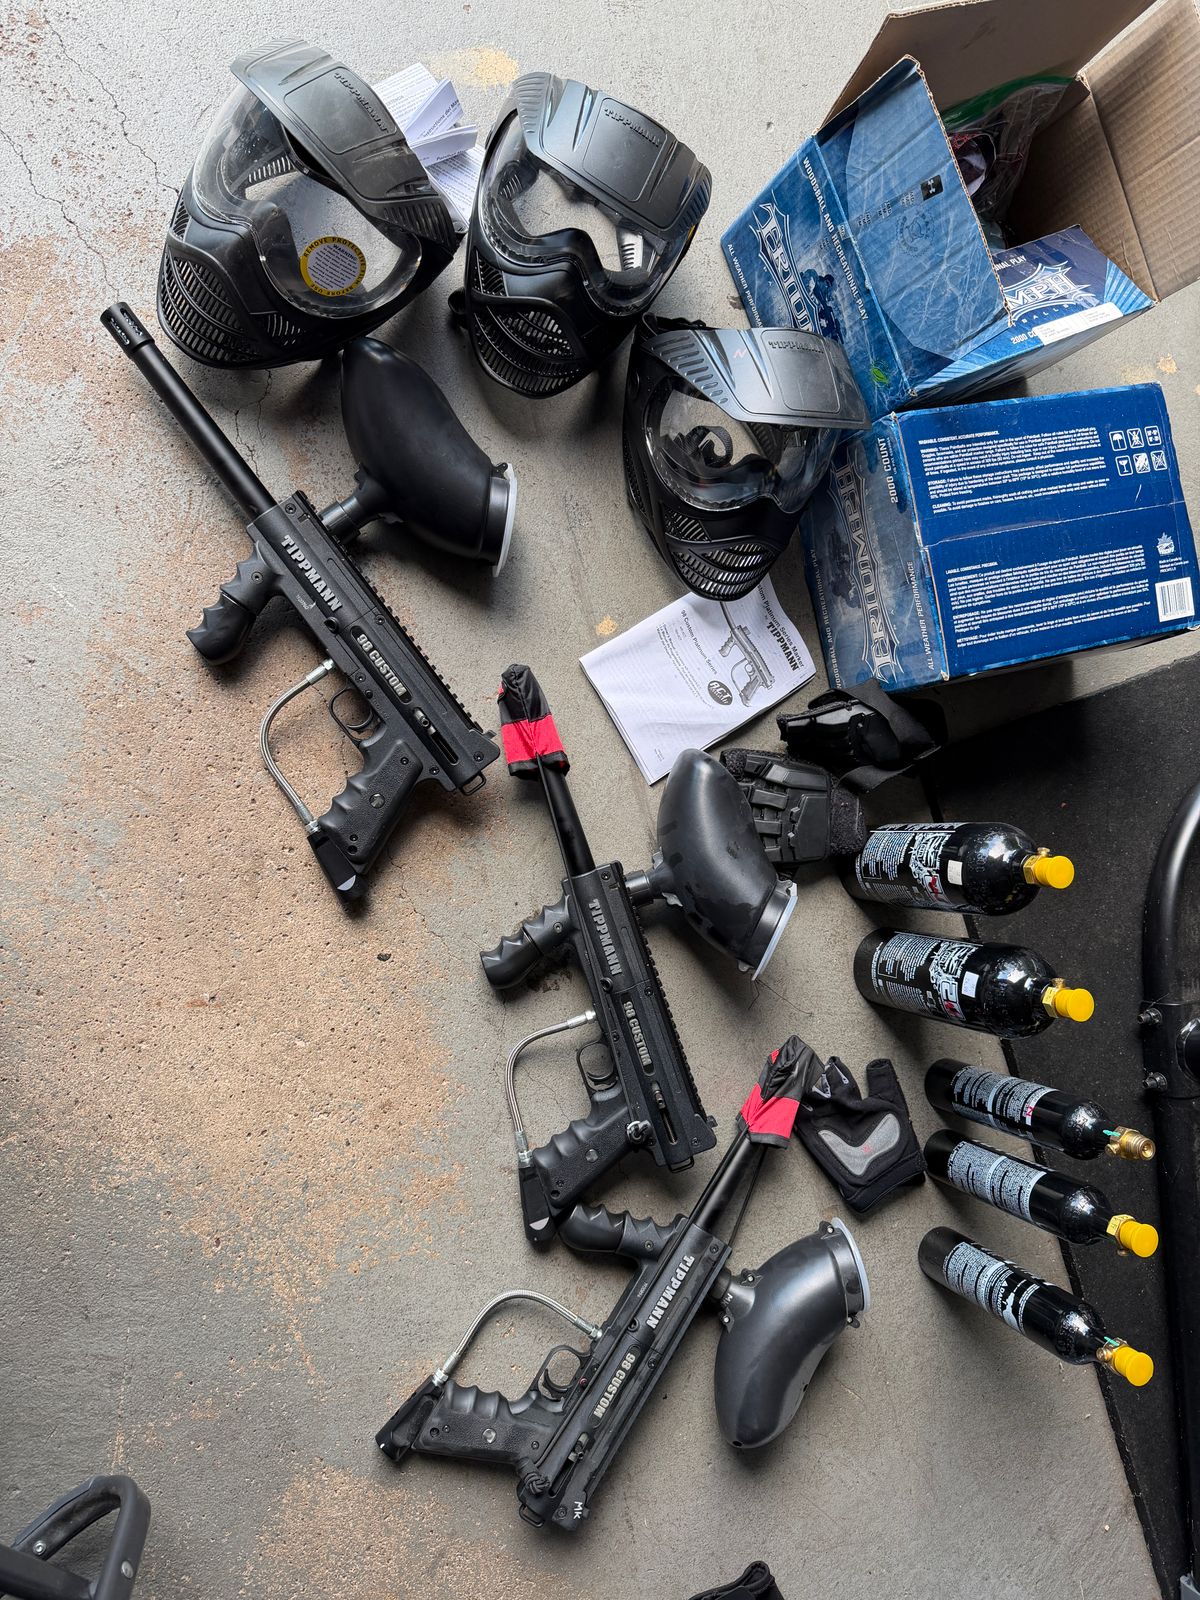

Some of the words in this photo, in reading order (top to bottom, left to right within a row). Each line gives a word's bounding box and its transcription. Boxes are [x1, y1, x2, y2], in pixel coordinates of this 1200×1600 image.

[333, 73, 389, 134] TIPPMANN
[803, 156, 824, 213] WOODSBALL
[824, 214, 834, 232] AND
[832, 234, 860, 303] RECREATIONAL
[857, 297, 868, 320] PLAY
[1010, 255, 1026, 266] PLAY
[728, 244, 736, 261] ALL
[733, 258, 748, 294] WEATHER
[1011, 334, 1028, 344] 2000
[878, 438, 891, 471] COUNT
[887, 476, 898, 503] 2000
[281, 534, 343, 612] TIPPMANN
[907, 560, 925, 617] PERFORMANCE
[684, 618, 694, 637] Custom
[693, 638, 707, 659] Platinum
[706, 659, 717, 674] Series
[763, 599, 781, 628] Platinum
[780, 625, 794, 647] Series
[792, 644, 805, 668] Marker
[766, 622, 800, 671] TIPPMANN
[919, 619, 932, 655] WEATHER
[356, 633, 374, 651] 98
[369, 649, 407, 696] CUSTOM
[927, 656, 935, 671] ALL
[710, 682, 731, 699] ACT
[588, 898, 623, 975] TIPPMANN
[623, 1001, 636, 1018] 98
[628, 1019, 652, 1067] CUSTOM
[646, 1255, 695, 1330] TIPPMANN
[621, 1352, 636, 1369] 98
[593, 1369, 626, 1419] CUSTOM
[573, 1501, 582, 1519] MK
